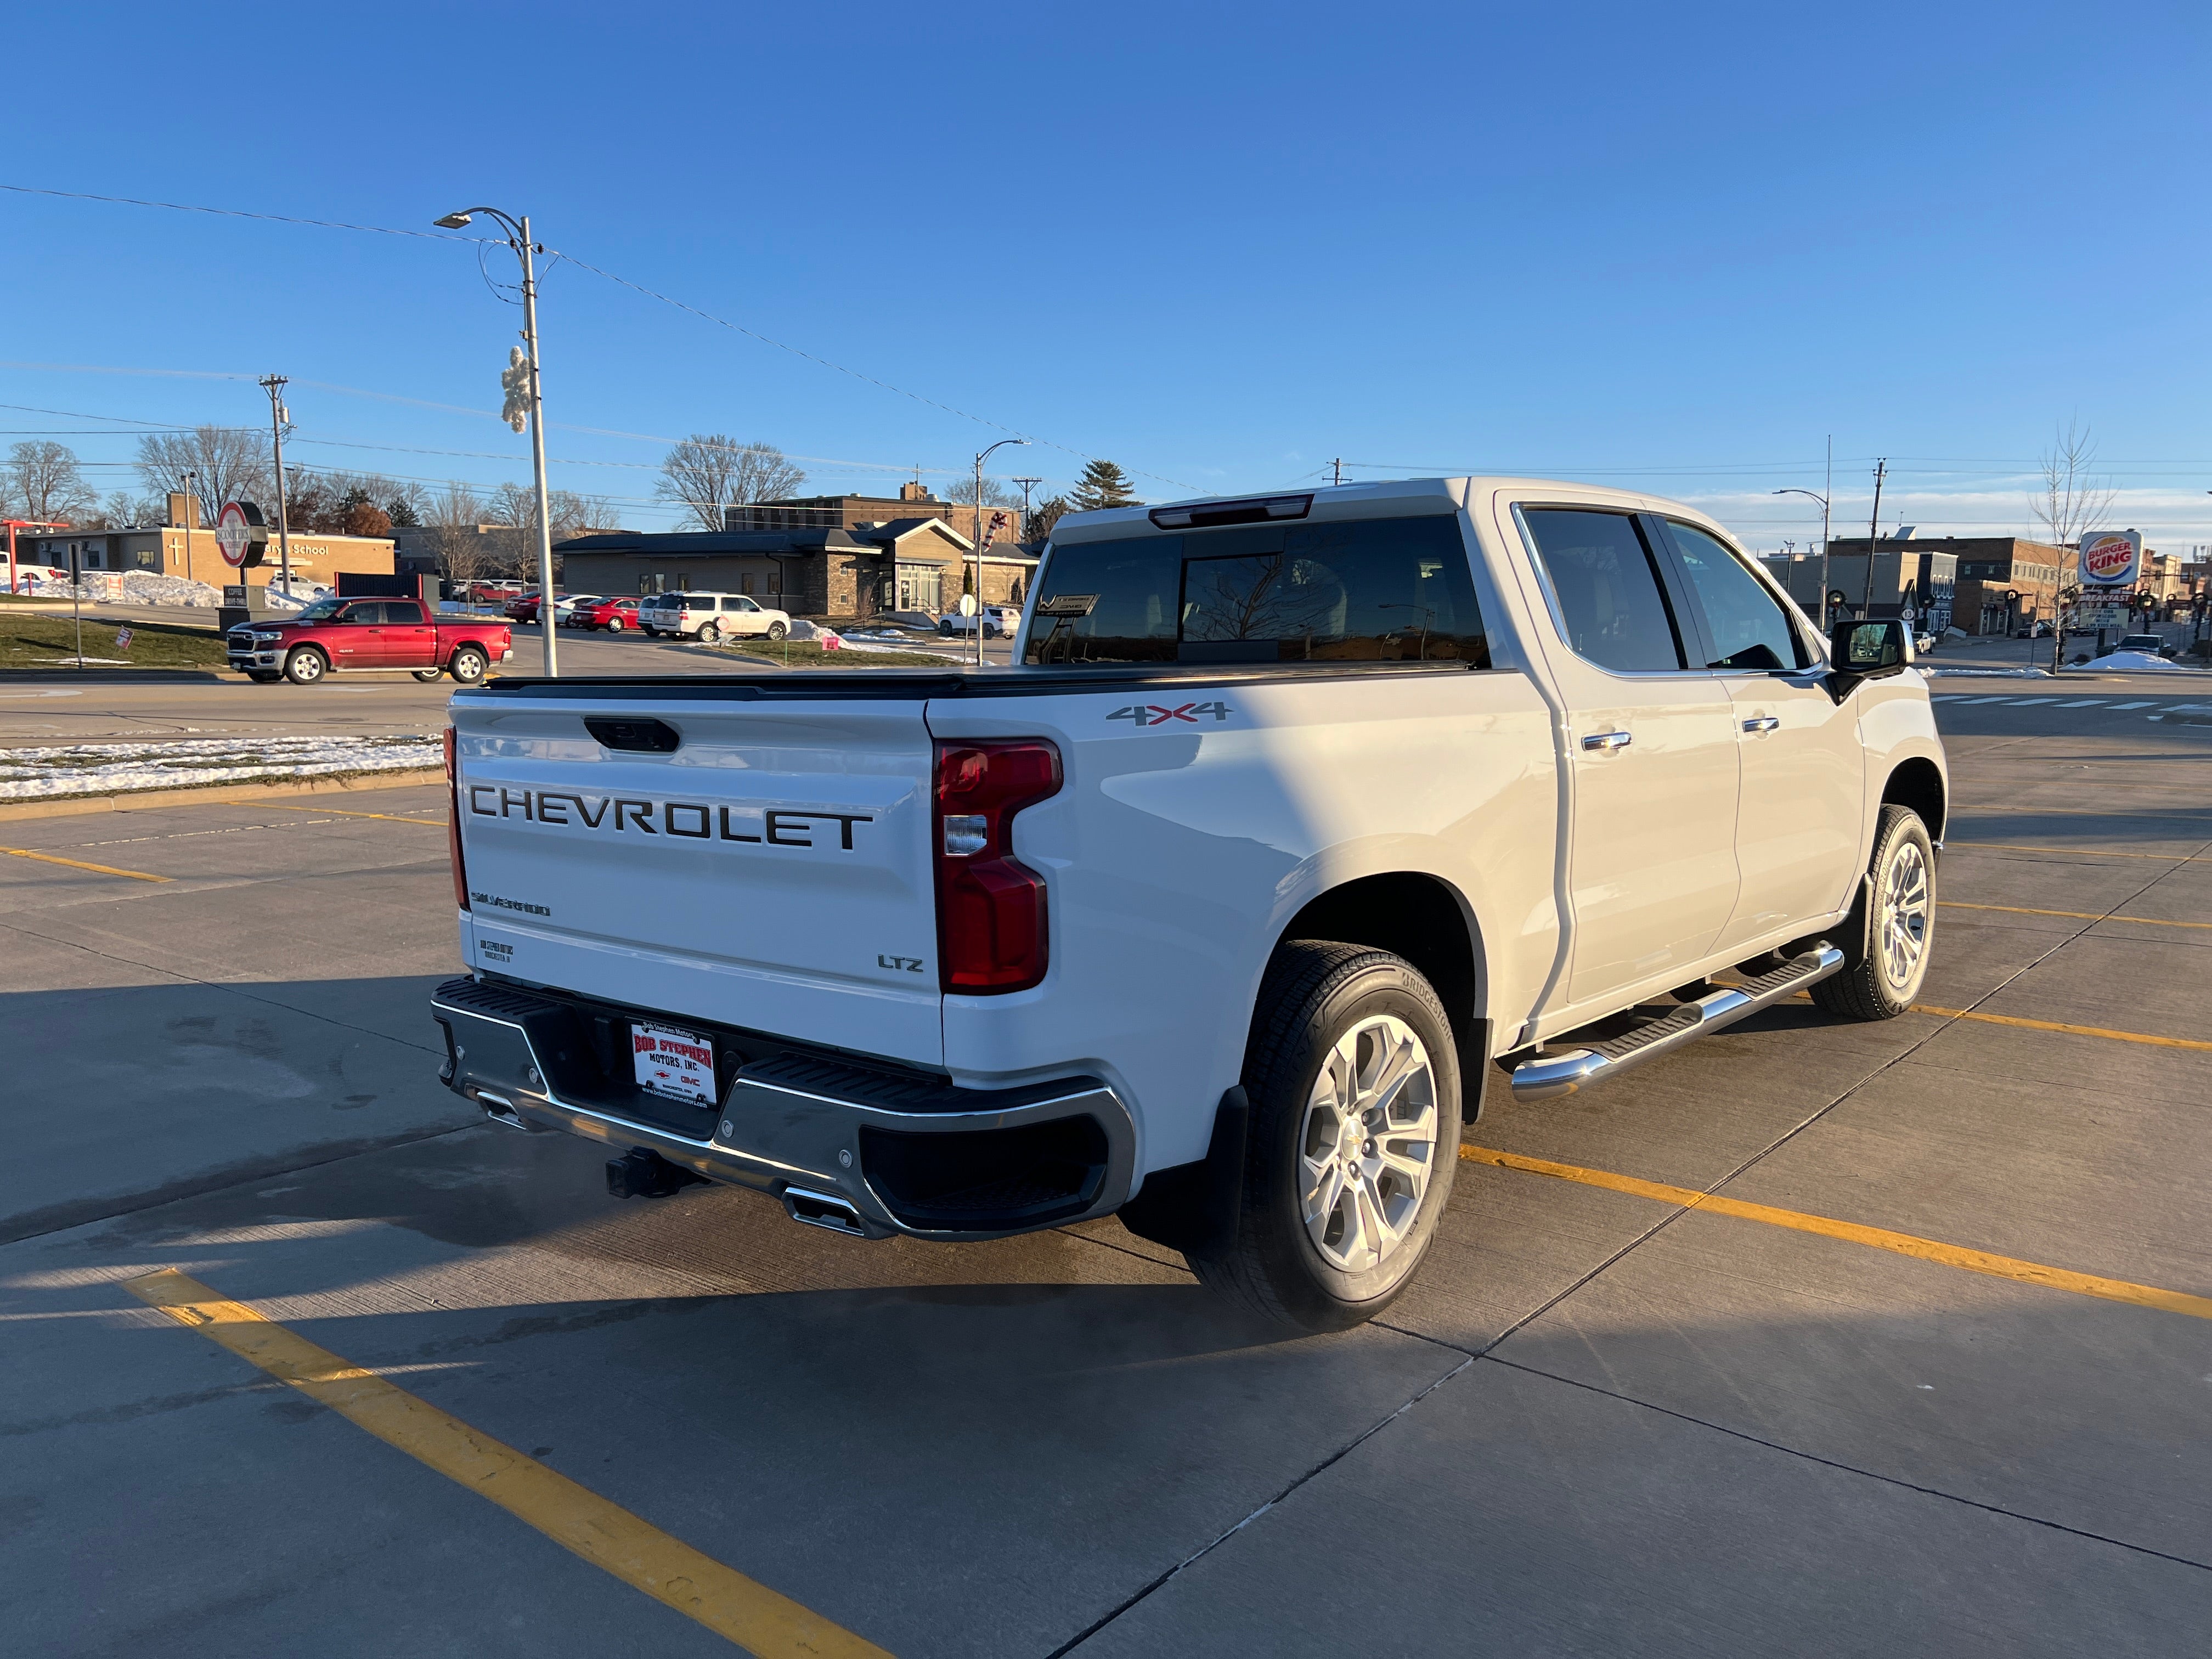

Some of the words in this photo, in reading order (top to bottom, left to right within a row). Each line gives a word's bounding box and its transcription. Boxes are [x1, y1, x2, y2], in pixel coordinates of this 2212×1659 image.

[294, 544, 329, 555] School
[2089, 543, 2131, 560] BURGER
[2090, 551, 2132, 572] KING
[471, 786, 873, 850] CHEVROLET
[471, 892, 551, 916] SILVERADO
[878, 954, 923, 973] LTZ
[654, 1024, 675, 1033] Stephen
[634, 1034, 657, 1053] BOB
[659, 1039, 712, 1070] STEPHEN
[649, 1053, 682, 1069] MOTORS,
[685, 1059, 700, 1071] INC.
[681, 1076, 701, 1087] GMC
